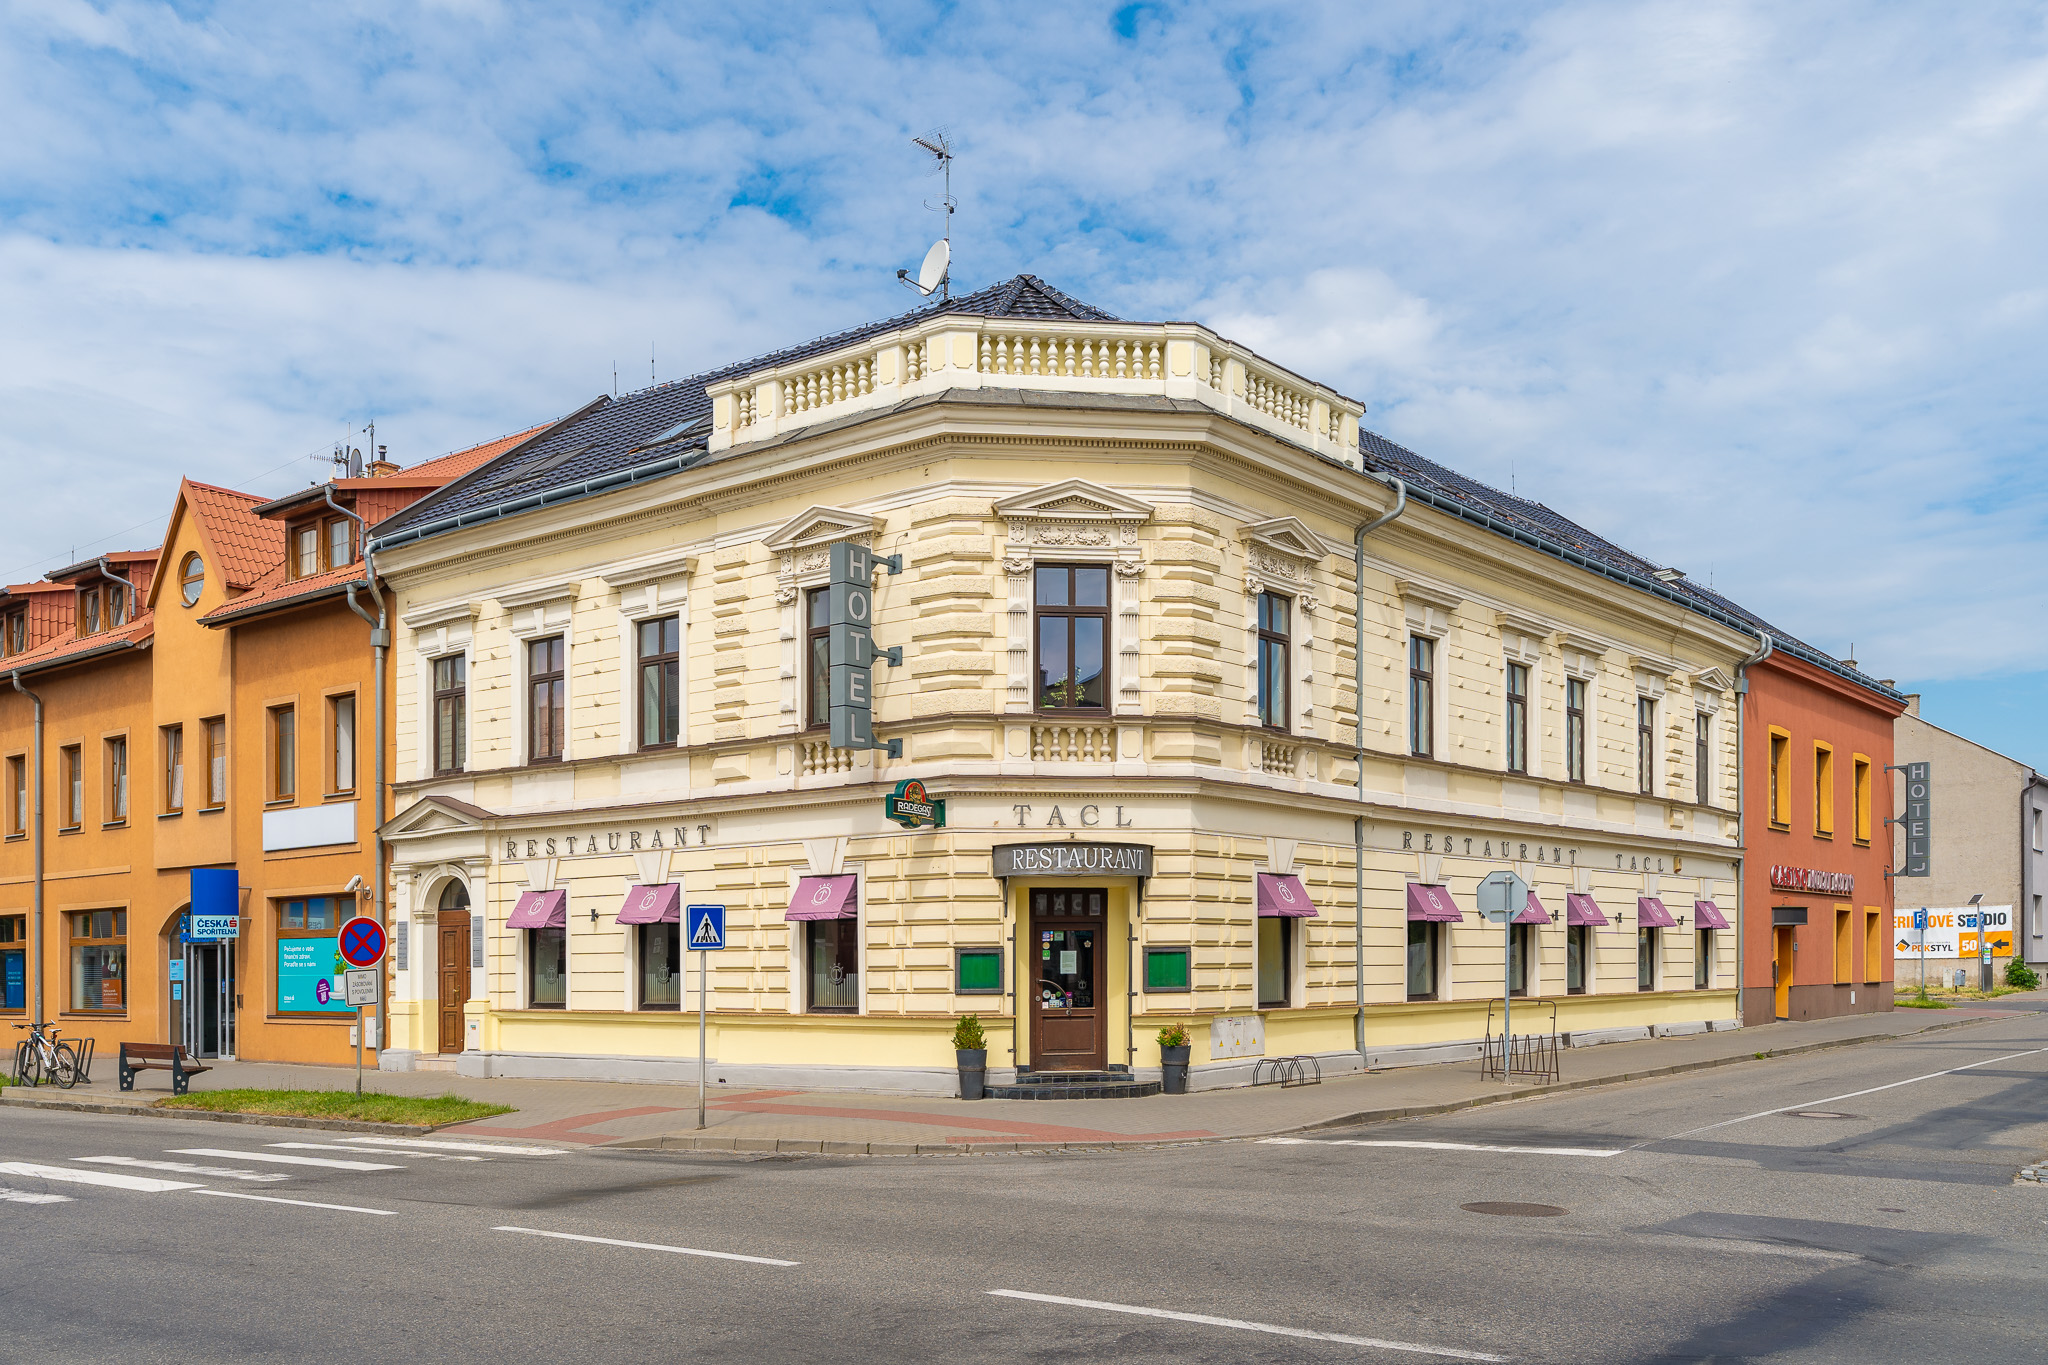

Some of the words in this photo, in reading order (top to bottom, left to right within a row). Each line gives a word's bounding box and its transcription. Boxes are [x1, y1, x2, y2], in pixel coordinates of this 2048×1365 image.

[848, 550, 867, 743] HOTEL
[898, 801, 932, 817] RADEGAST
[1013, 804, 1133, 827] TACL
[1911, 764, 1926, 856] HOTEL
[506, 824, 711, 859] RESTAURANT
[1403, 830, 1578, 866] RESTAURANT
[1616, 853, 1665, 872] TACL
[1012, 847, 1144, 870] RESTAURANT
[1771, 864, 1808, 887] CASINO
[197, 917, 229, 928] ČESKÁ
[1957, 912, 2007, 927] SDIO
[1961, 939, 1977, 951] 50
